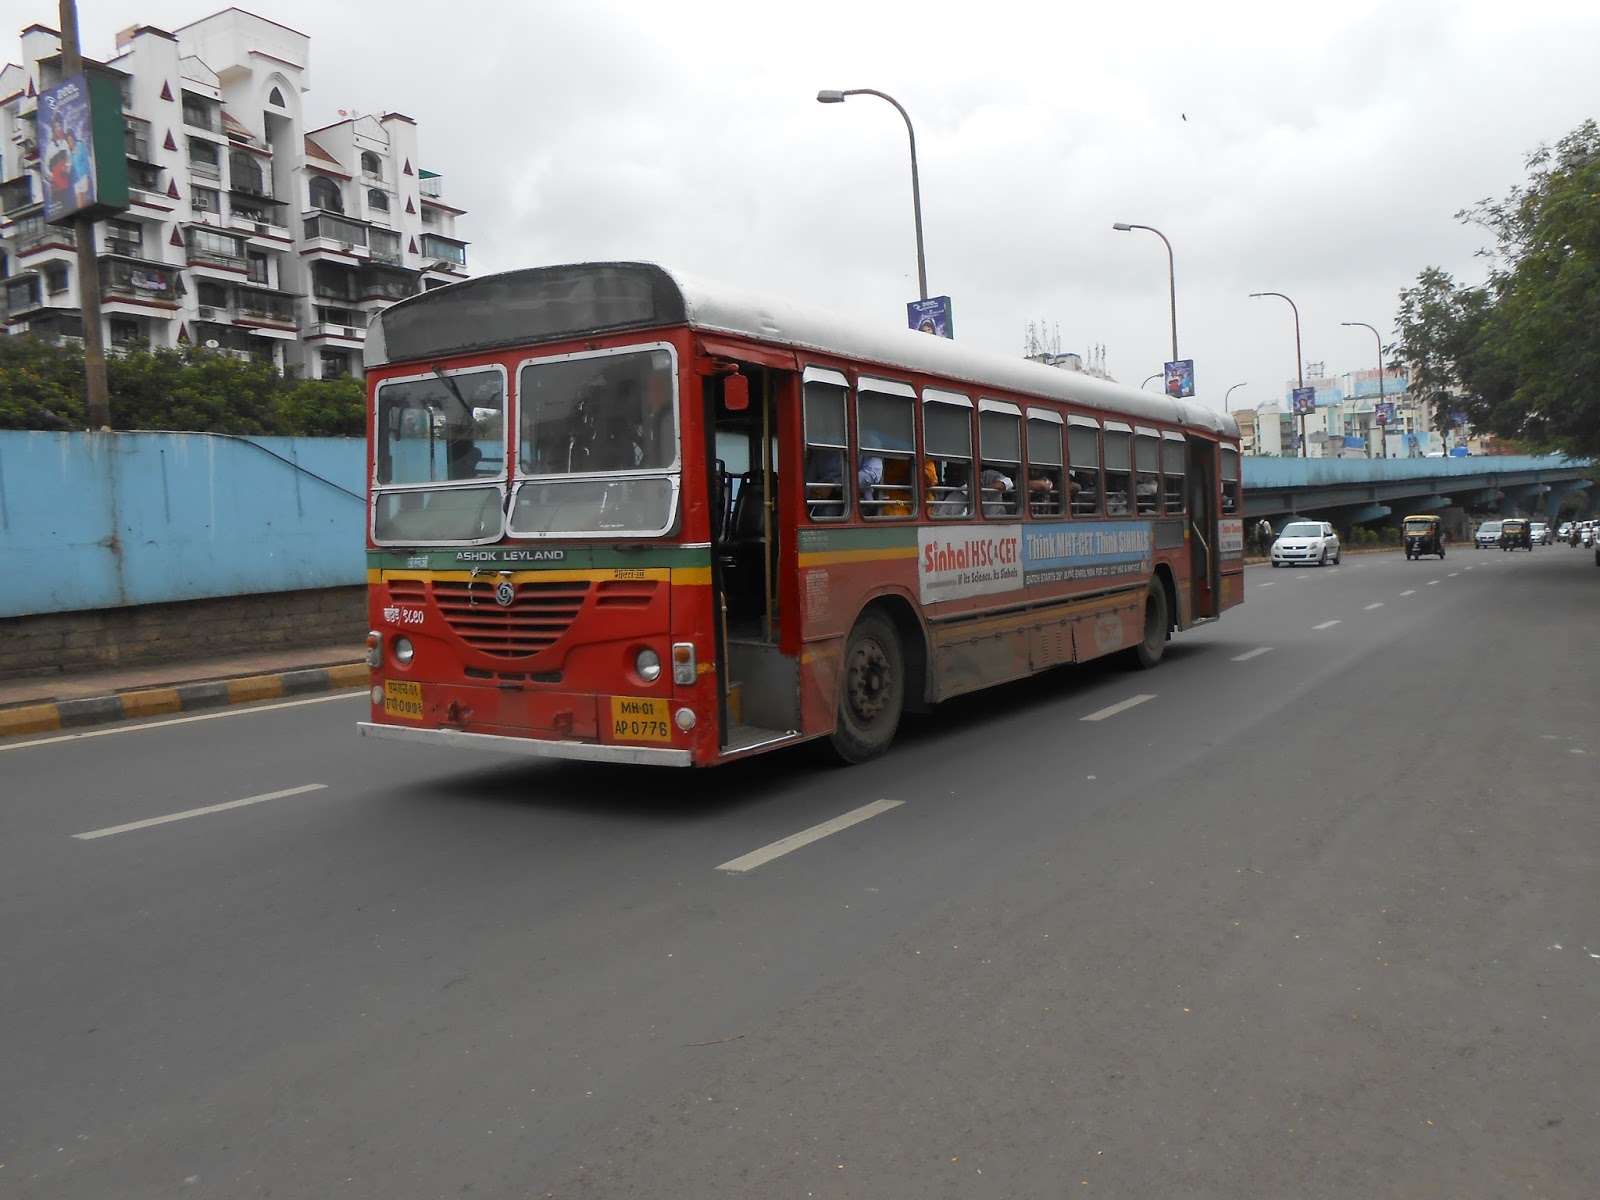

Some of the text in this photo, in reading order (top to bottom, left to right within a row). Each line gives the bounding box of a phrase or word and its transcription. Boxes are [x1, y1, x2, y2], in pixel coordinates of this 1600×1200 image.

[456, 550, 564, 561] ASHOK LEYLAND
[925, 541, 970, 573] Sinhal
[972, 539, 994, 567] HSC
[999, 538, 1017, 564] CET
[1027, 533, 1056, 560] Think
[1096, 531, 1118, 555] Think
